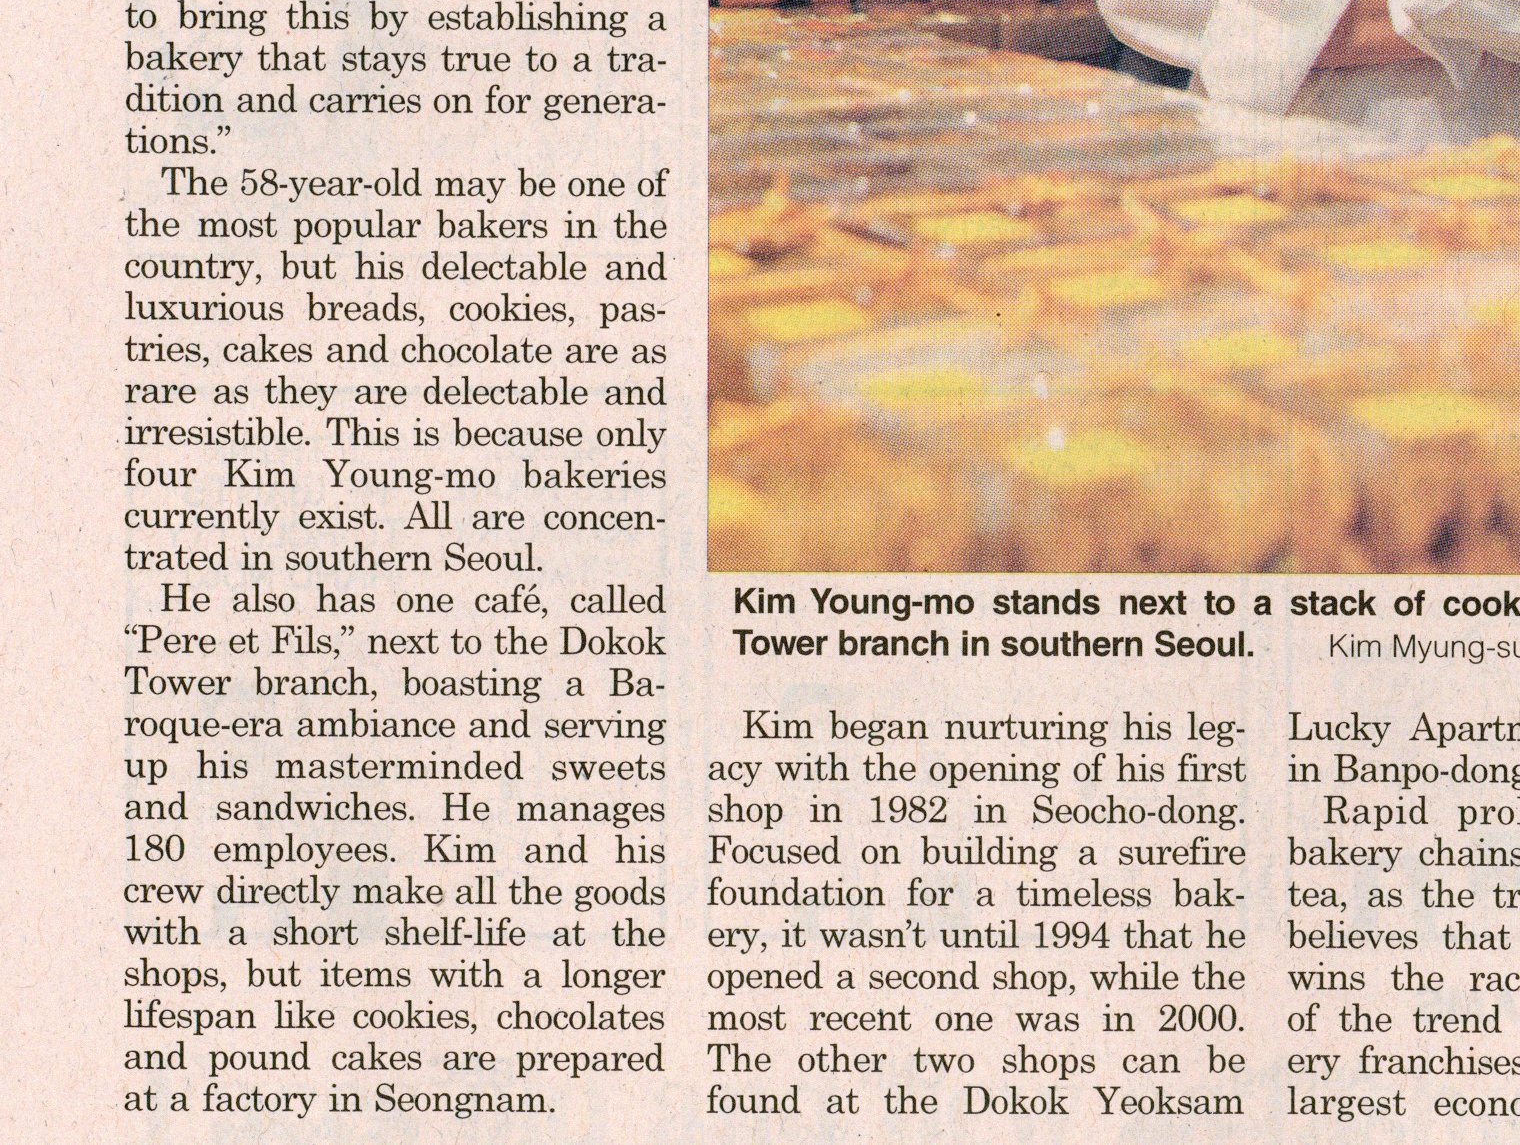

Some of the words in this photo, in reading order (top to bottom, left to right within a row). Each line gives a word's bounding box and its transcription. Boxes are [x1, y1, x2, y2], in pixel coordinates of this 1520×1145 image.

[124, 2, 157, 29] to
[176, 0, 268, 37] bring
[285, 0, 350, 31] this
[368, 0, 409, 38] by
[427, 0, 629, 39] establishing
[647, 11, 667, 32] a
[124, 253, 262, 287] country,
[279, 249, 337, 280] but
[354, 250, 404, 281] his
[421, 250, 587, 281] delectable
[605, 251, 668, 281] and
[124, 499, 281, 537] currently
[298, 500, 385, 530] exist.
[403, 500, 453, 530] All
[472, 510, 525, 531] are
[543, 510, 666, 531] concen-
[734, 587, 796, 615] Kim
[810, 587, 975, 622] Young-mo
[992, 588, 1101, 616] stands
[1119, 590, 1187, 616] next
[1203, 590, 1236, 616] to
[1253, 594, 1273, 616] a
[1290, 589, 1377, 617] stack
[1393, 589, 1426, 617] of
[732, 628, 829, 657] Tower
[838, 629, 950, 657] branch
[961, 629, 990, 657] in
[1000, 630, 1143, 658] southern
[1154, 629, 1254, 658] Seoul.
[1329, 633, 1382, 658] Kim
[1288, 711, 1392, 749] Lucky
[123, 758, 168, 786] up
[196, 749, 249, 780] his
[274, 750, 524, 781] masterminded
[551, 754, 666, 782] sweets
[707, 792, 784, 830] shop
[809, 793, 843, 823] in
[870, 795, 948, 824] 1982
[973, 794, 1007, 824] in
[1032, 794, 1245, 832] Seocho-dong.
[1287, 1002, 1321, 1032] of
[1338, 1002, 1393, 1033] the
[1412, 1003, 1503, 1034] trend
[123, 1040, 188, 1071] and
[208, 1040, 311, 1078] pound
[331, 1040, 423, 1072] cakes
[442, 1050, 496, 1071] are
[515, 1042, 666, 1079] prepared
[706, 1042, 772, 1073] The
[797, 1043, 888, 1075] other
[912, 1046, 975, 1074] two
[1002, 1043, 1096, 1081] shops
[1122, 1053, 1181, 1074] can
[1206, 1043, 1246, 1074] be
